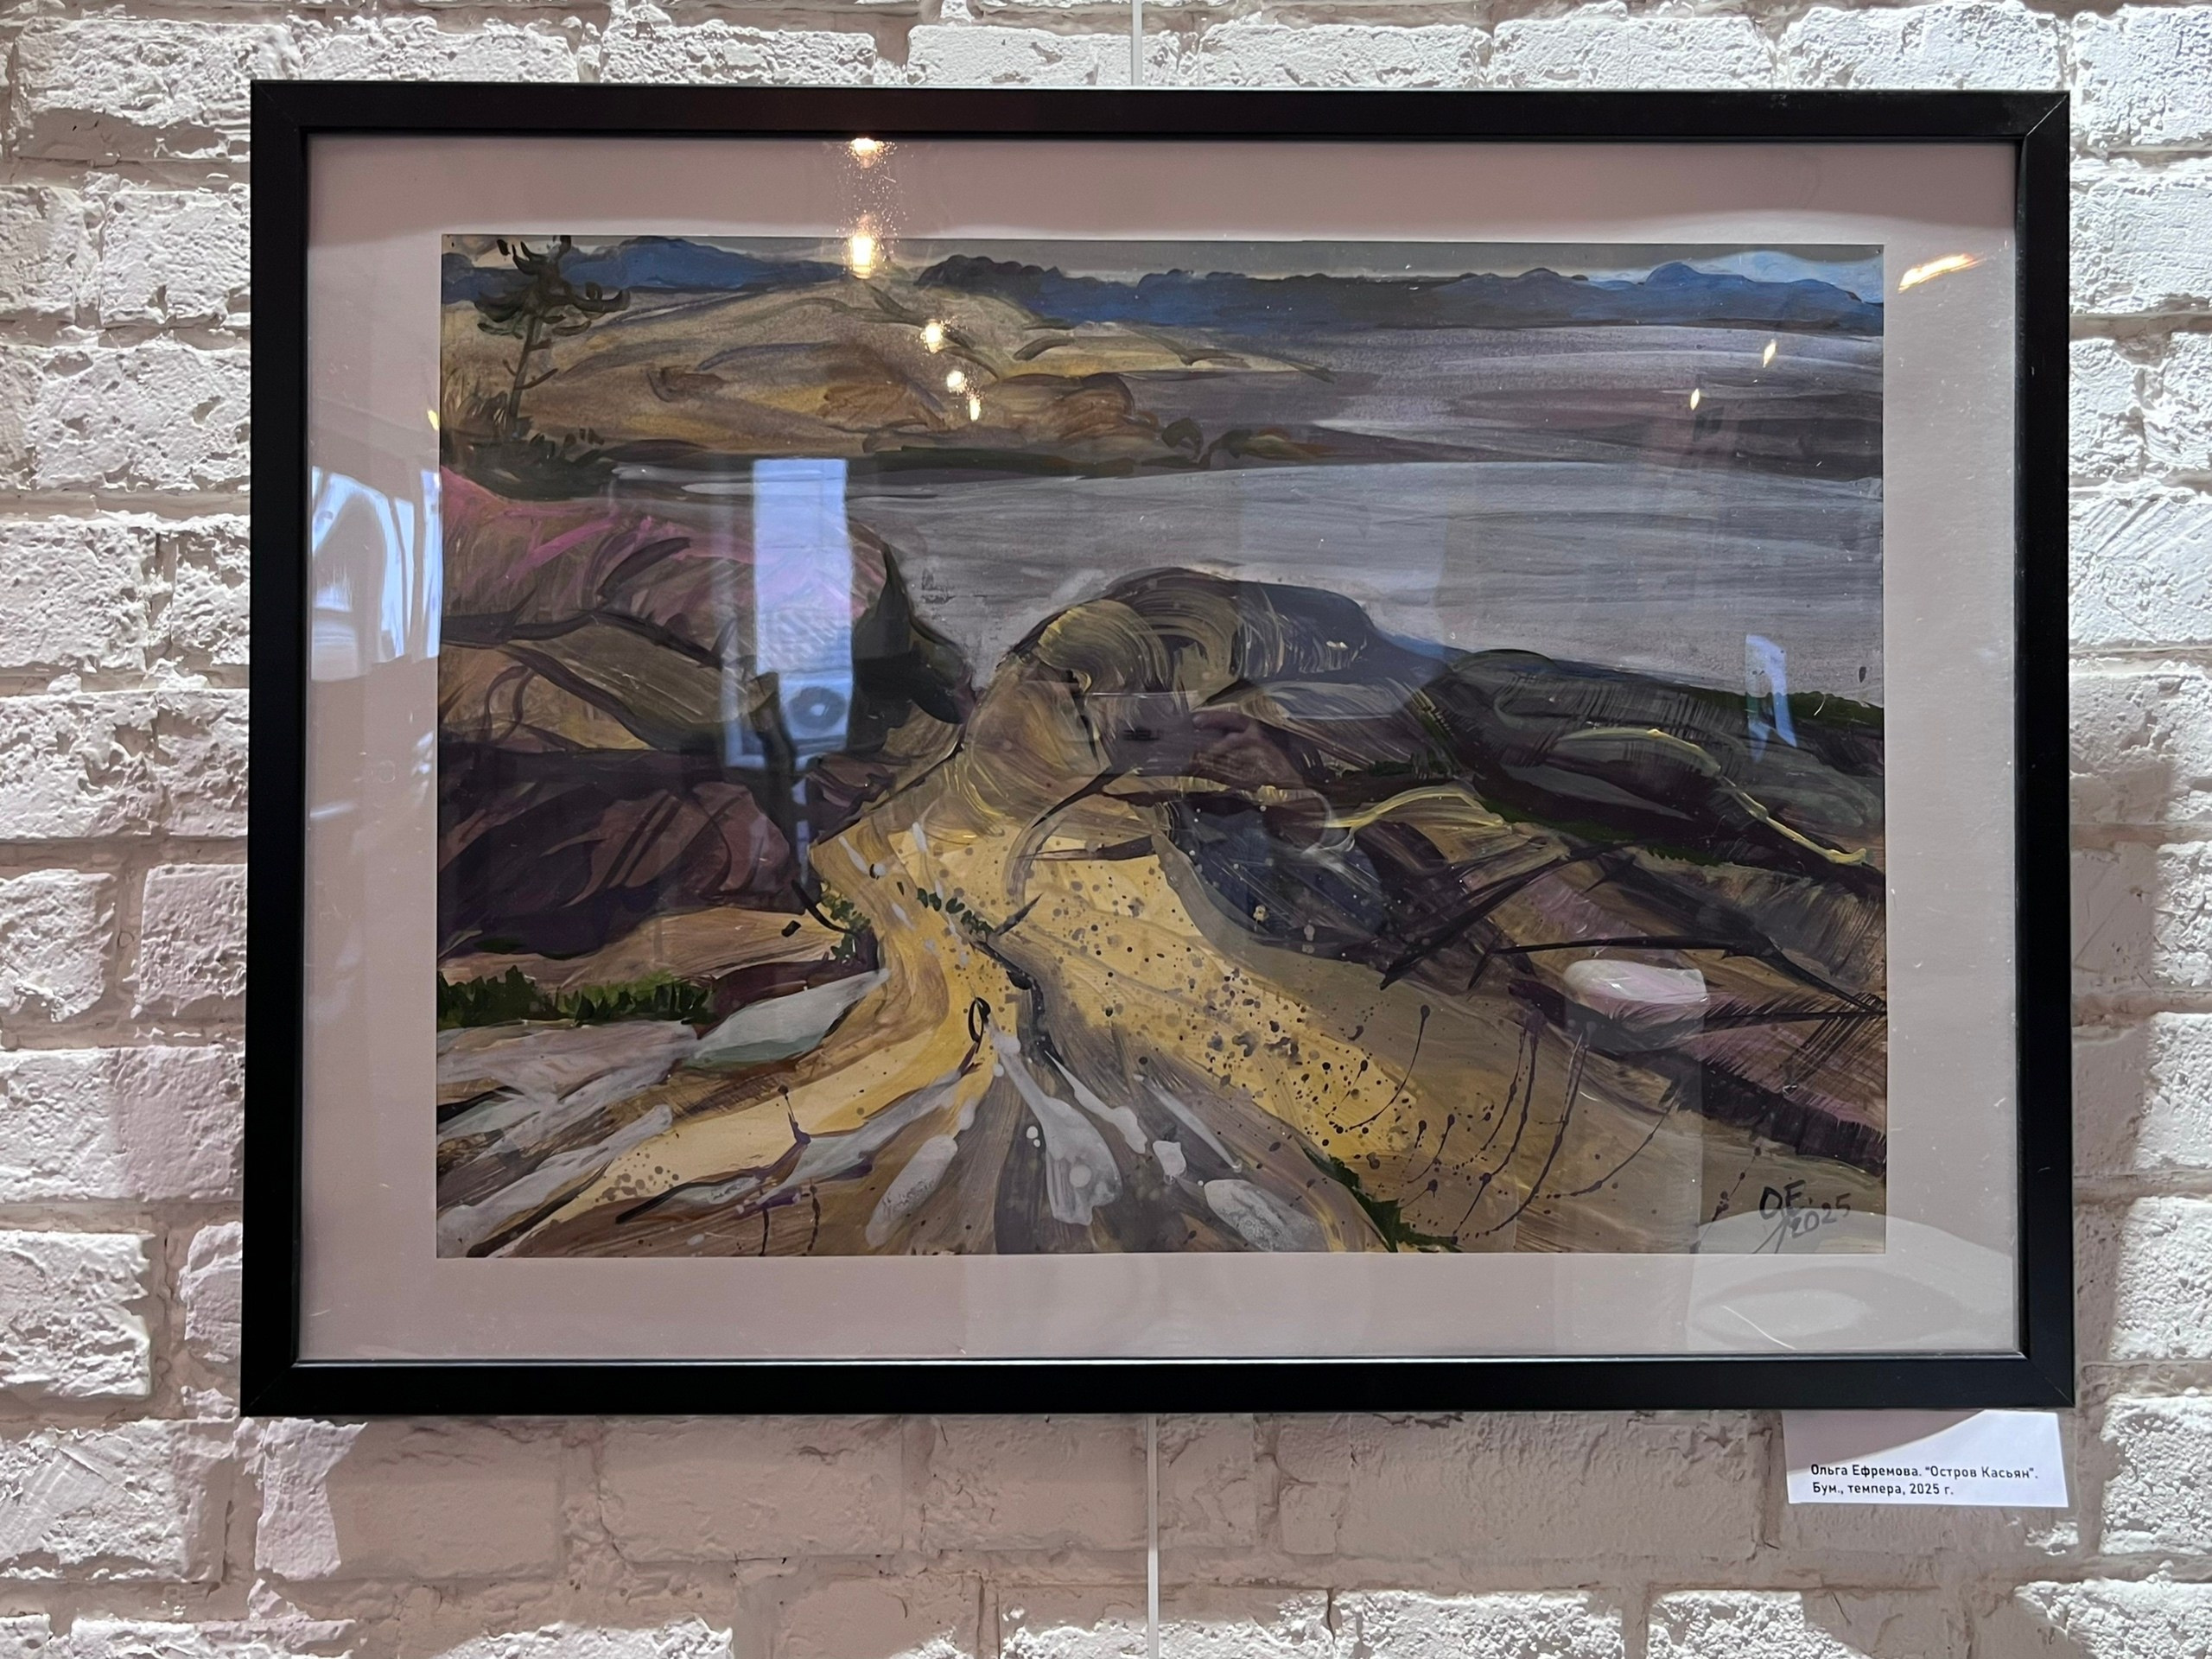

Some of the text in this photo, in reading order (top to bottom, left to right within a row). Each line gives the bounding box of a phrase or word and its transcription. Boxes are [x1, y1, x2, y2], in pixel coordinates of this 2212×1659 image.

[1789, 1192, 1851, 1239] 2025
[1811, 1463, 2038, 1480] Ольга Ефремова. "Остров Касьян".
[1813, 1482, 1954, 1497] Бум., темпера, 2025 г.
